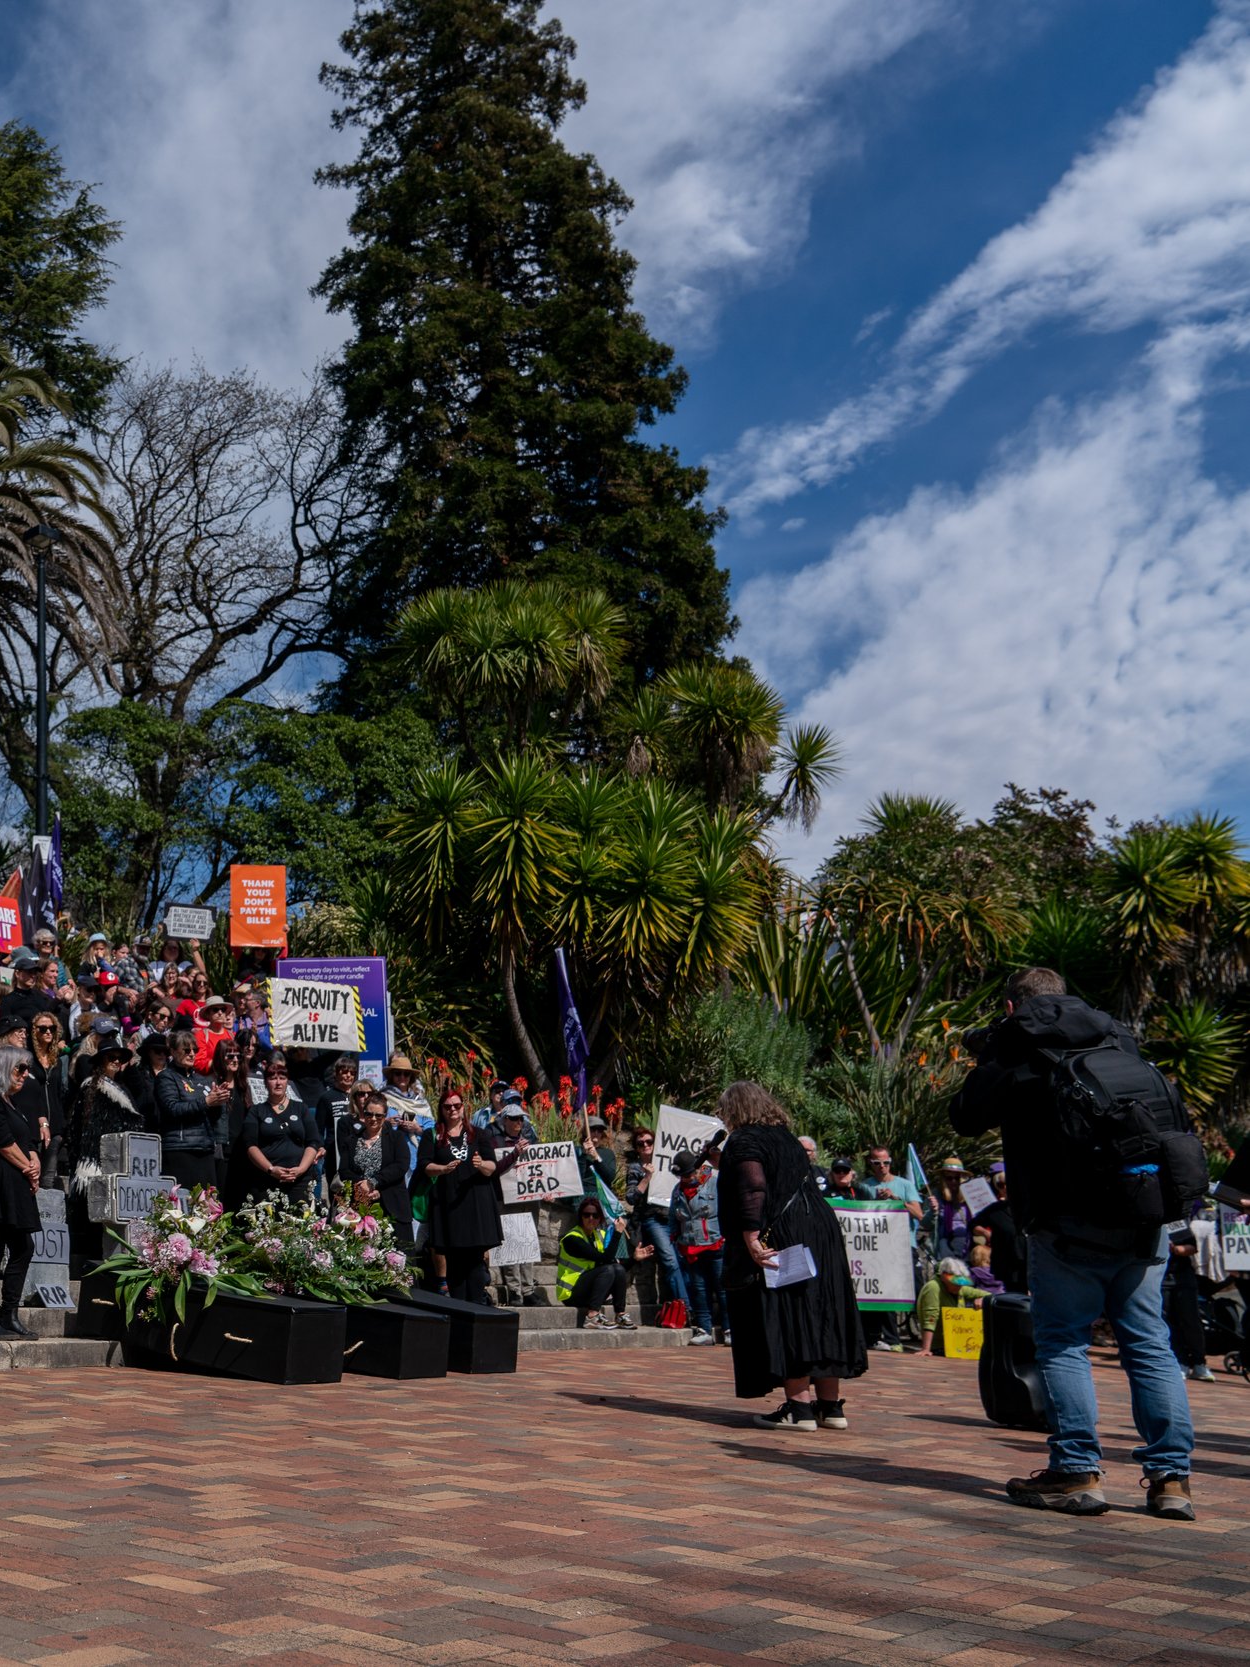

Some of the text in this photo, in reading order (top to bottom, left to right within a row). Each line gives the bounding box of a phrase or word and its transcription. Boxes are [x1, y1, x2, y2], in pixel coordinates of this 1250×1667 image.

[242, 880, 274, 888] THANK
[244, 898, 273, 906] DON'T
[2, 922, 12, 940] IT
[312, 973, 324, 981] light
[281, 986, 350, 1014] INEQUITY
[292, 1024, 339, 1043] ALIVE
[132, 1156, 157, 1177] RIP
[528, 1164, 543, 1177] IS
[518, 1177, 560, 1195] DEAD
[854, 1217, 870, 1233] TE
[874, 1216, 889, 1234] HĀ
[864, 1278, 883, 1294] US.
[40, 1286, 67, 1305] RIP
